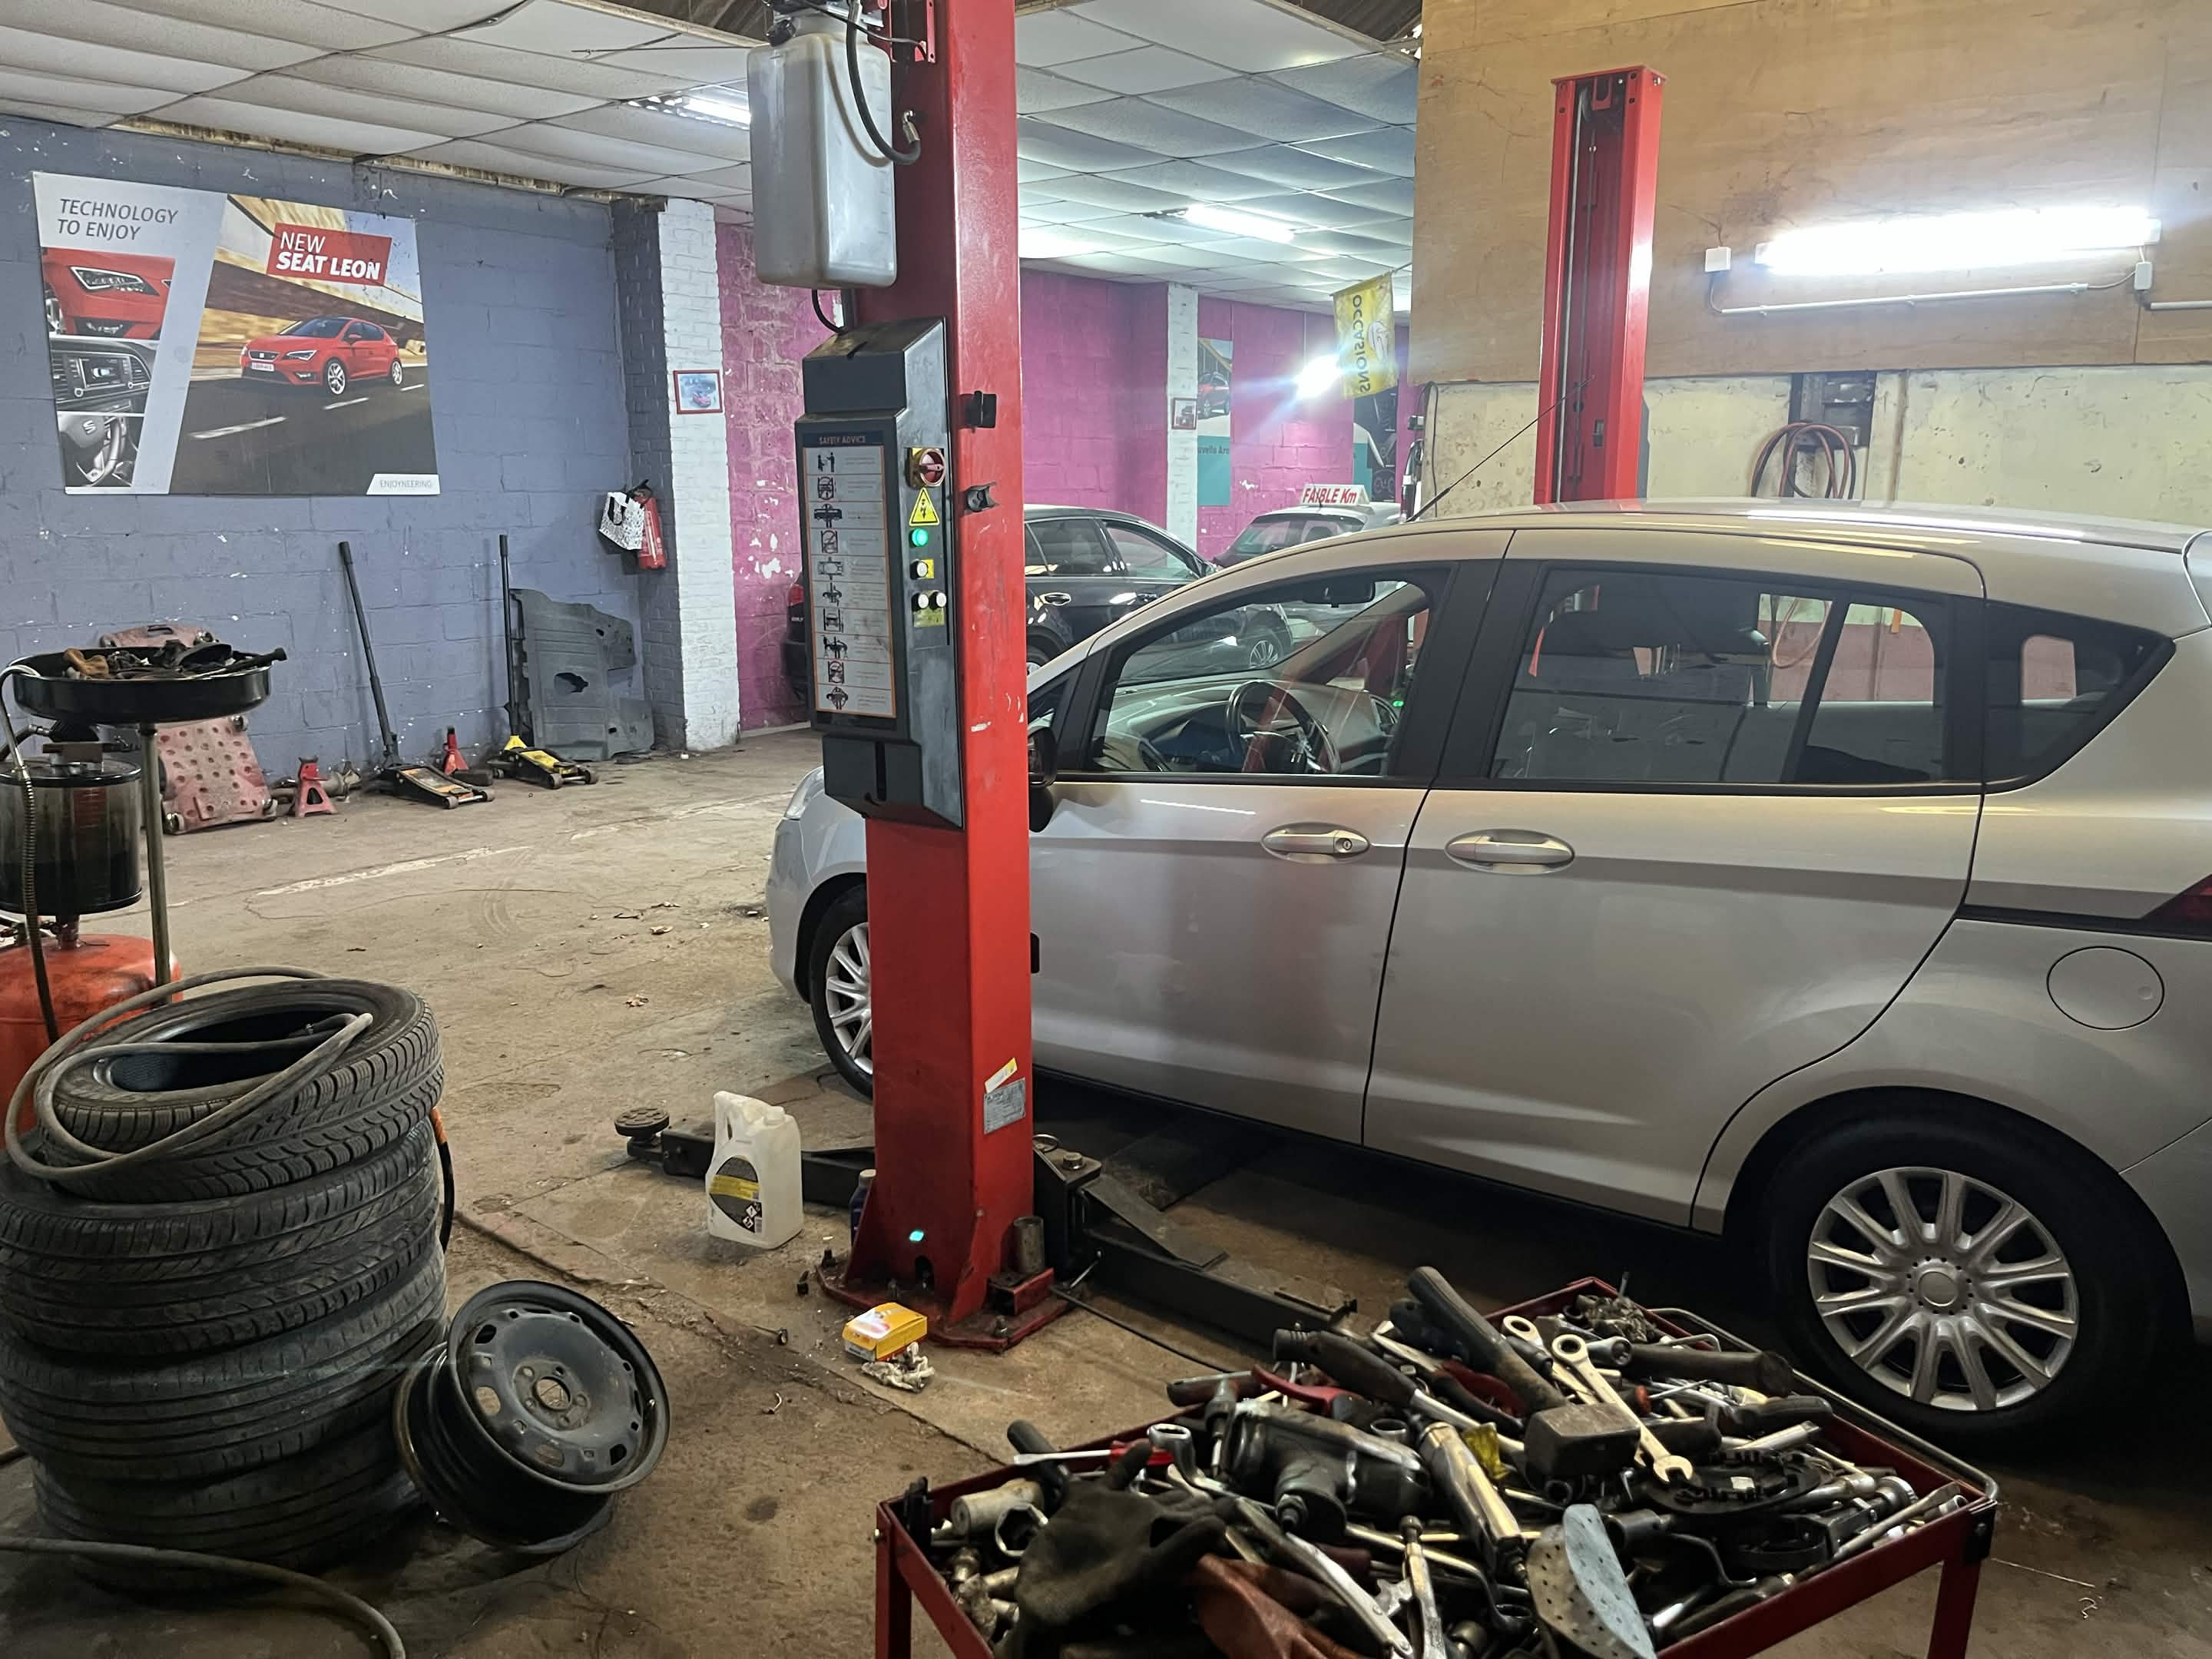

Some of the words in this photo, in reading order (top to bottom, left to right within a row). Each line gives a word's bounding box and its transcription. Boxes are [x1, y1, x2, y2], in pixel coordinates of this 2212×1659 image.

[60, 198, 178, 224] TECHNOLOGY
[58, 219, 81, 235] TO
[86, 222, 141, 240] ENJOY
[280, 231, 326, 253] NEW
[276, 251, 328, 273] SEAT
[329, 257, 380, 280] LEON
[380, 479, 432, 488] ENJOYNEERING
[1303, 488, 1340, 504] FAIBLE
[1339, 488, 1357, 504] Km
